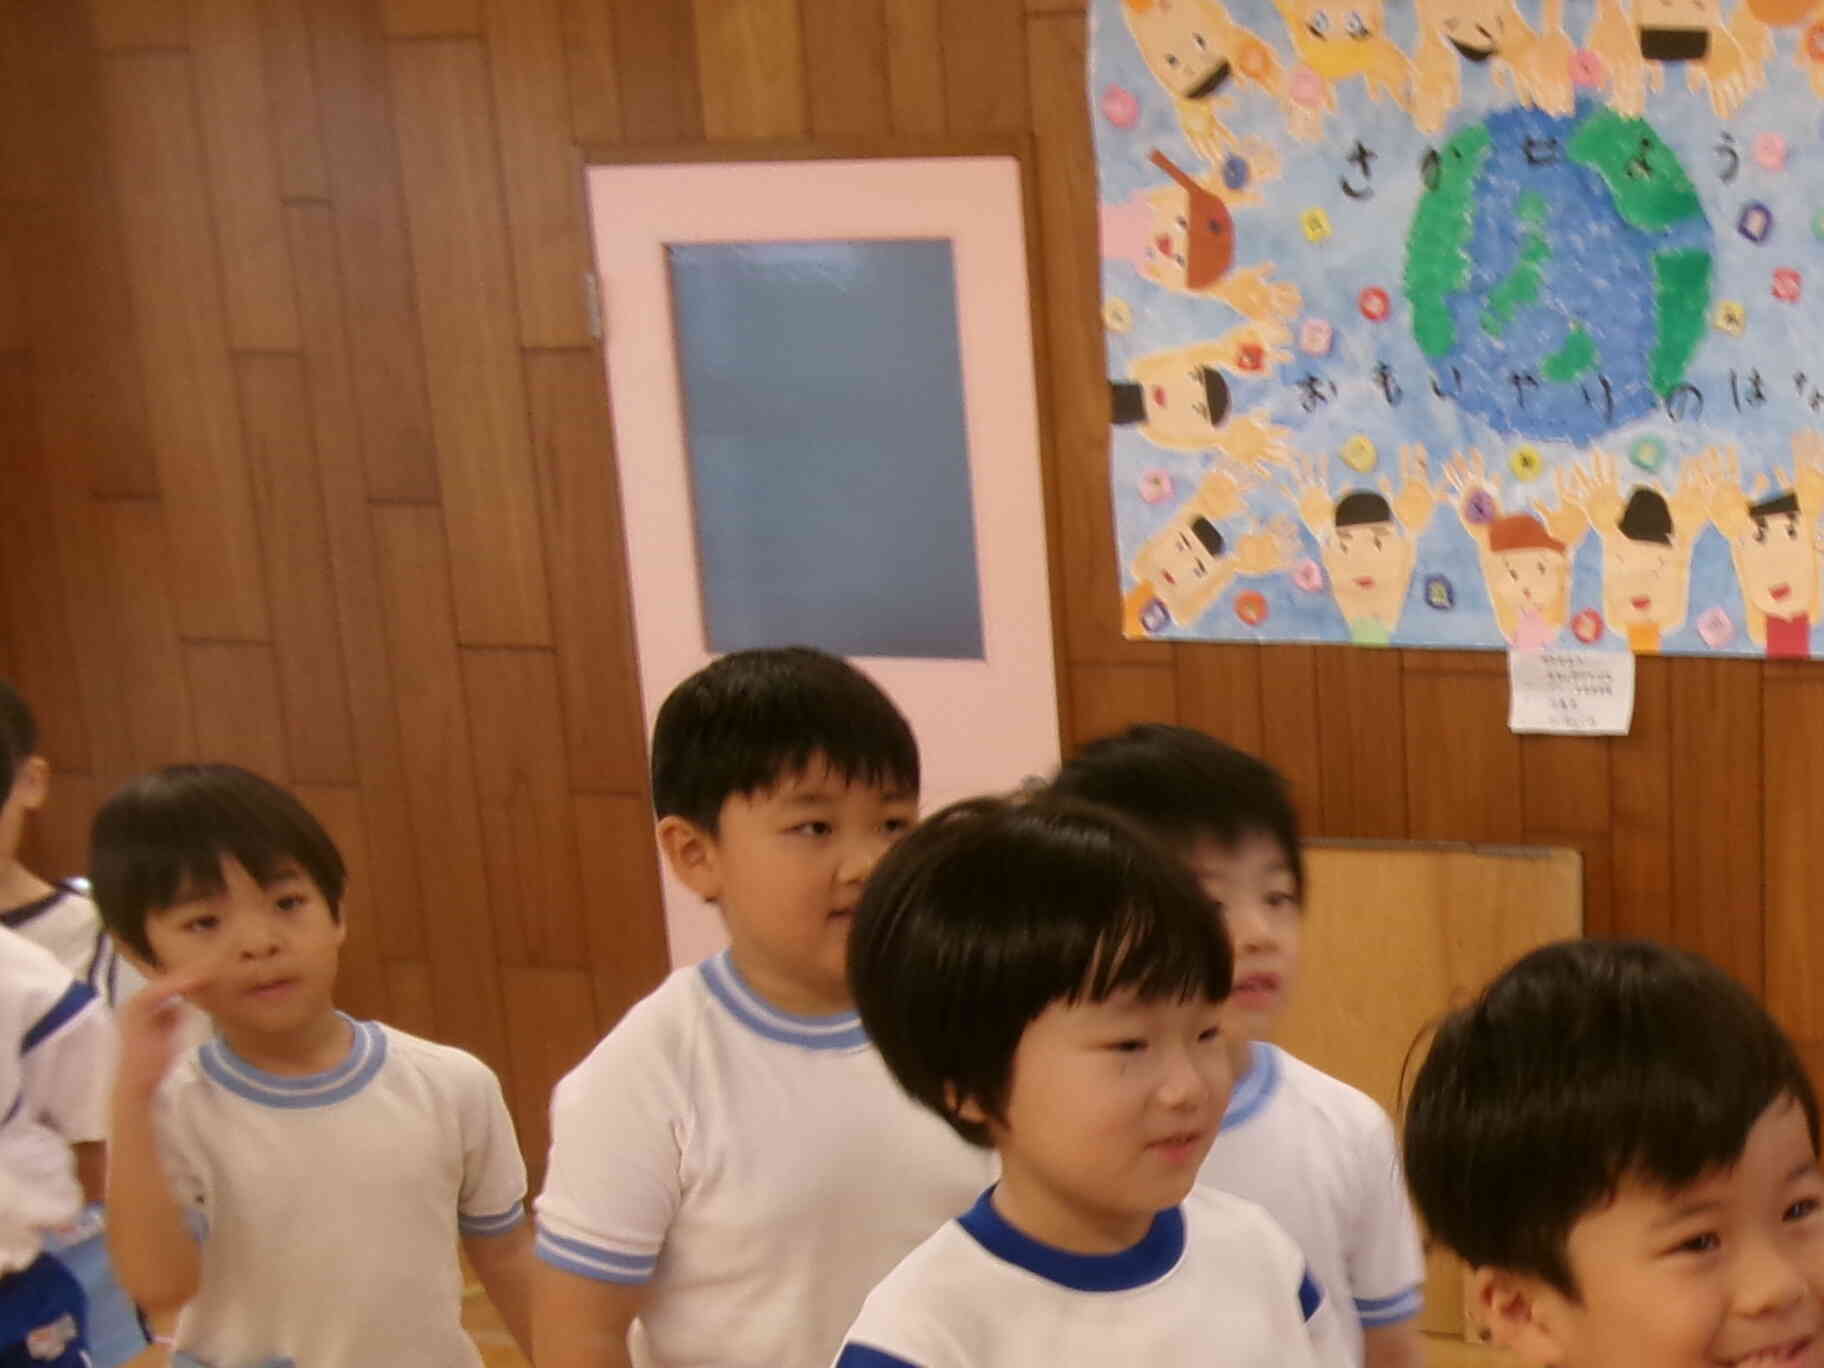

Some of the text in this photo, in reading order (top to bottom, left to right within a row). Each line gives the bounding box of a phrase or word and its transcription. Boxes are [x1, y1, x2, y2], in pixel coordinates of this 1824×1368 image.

[1340, 131, 1740, 200] さかせよう
